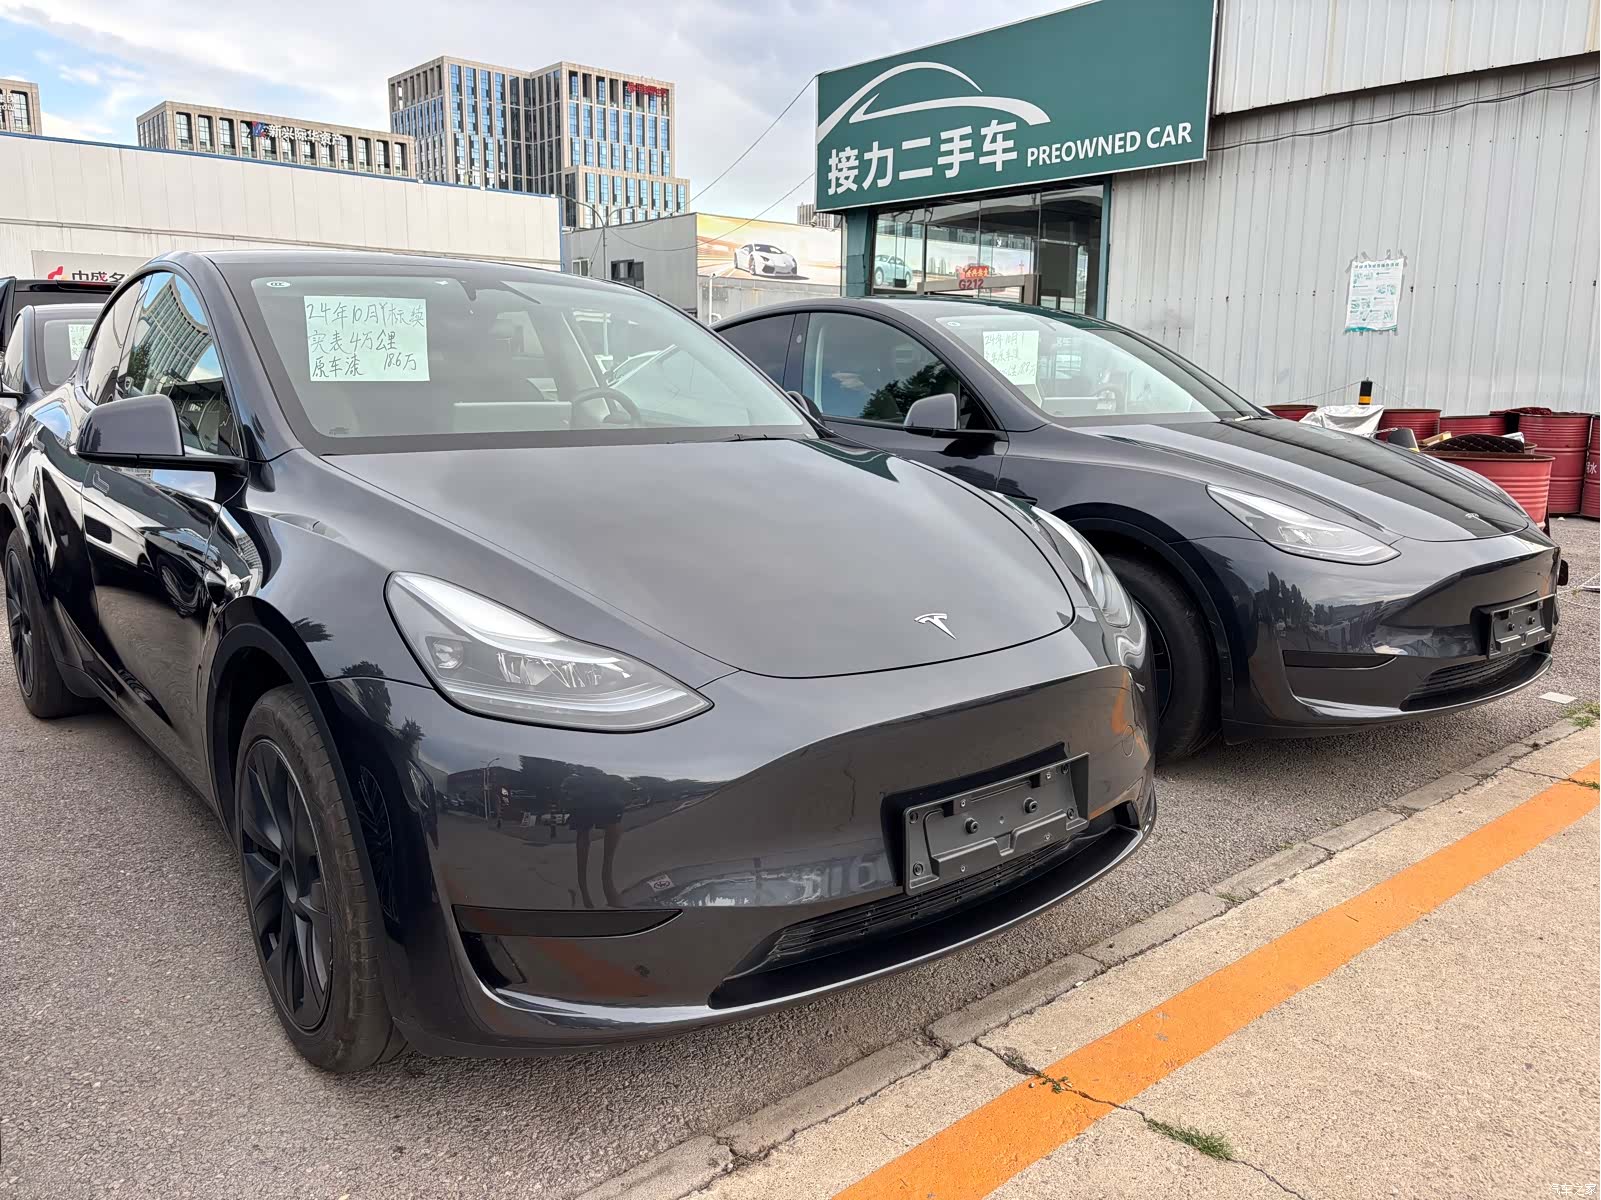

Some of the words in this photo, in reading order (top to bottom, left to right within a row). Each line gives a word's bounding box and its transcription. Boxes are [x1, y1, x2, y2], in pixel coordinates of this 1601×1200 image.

[268, 123, 343, 146] 新兴际华资产
[1026, 130, 1142, 168] PREOWNED
[1146, 121, 1193, 150] CAR
[827, 119, 1018, 196] 接力二手车
[958, 278, 984, 290] G212
